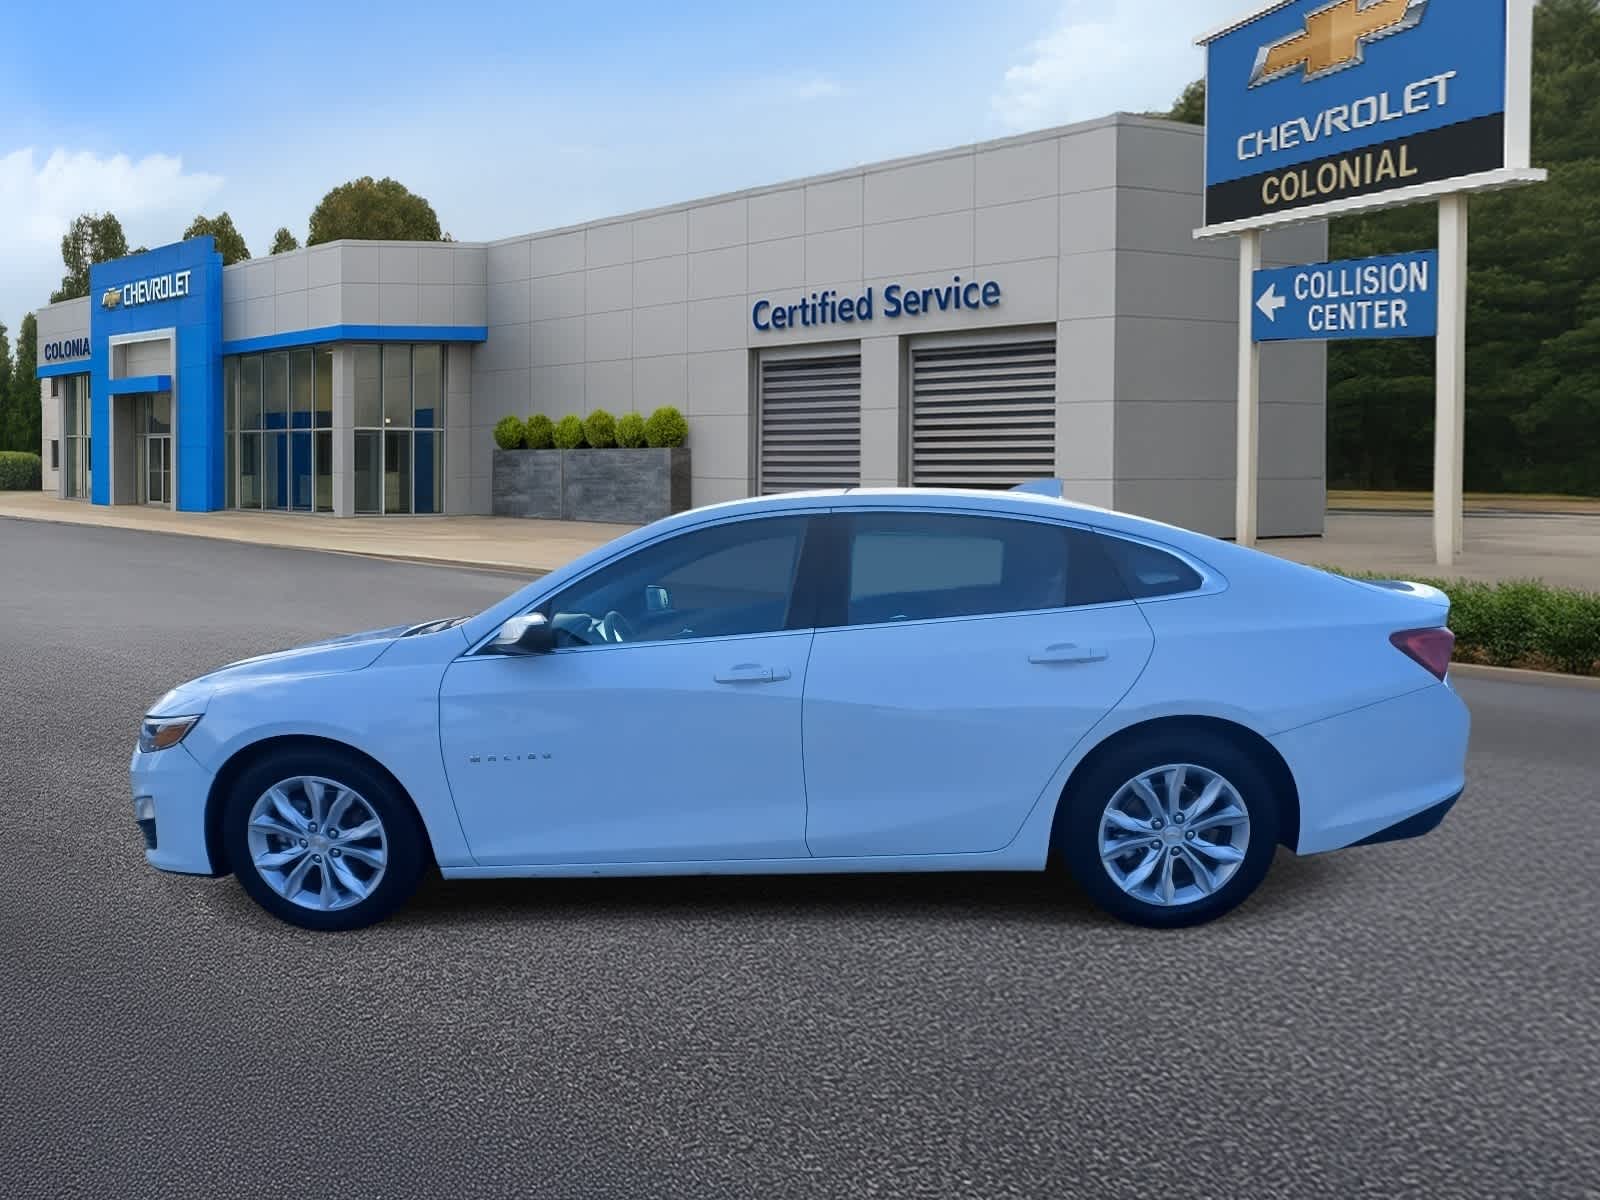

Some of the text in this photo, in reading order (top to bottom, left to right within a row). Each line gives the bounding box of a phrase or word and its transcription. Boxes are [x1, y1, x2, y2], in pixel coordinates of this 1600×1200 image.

[1237, 70, 1457, 160] CHEVROLET
[1261, 145, 1418, 205] COLONIAL
[123, 270, 191, 306] CHEVROLET
[1294, 261, 1428, 301] COLLISION
[752, 276, 1001, 331] Certified Service
[1308, 299, 1408, 332] CENTER
[44, 337, 91, 361] COLONIA
